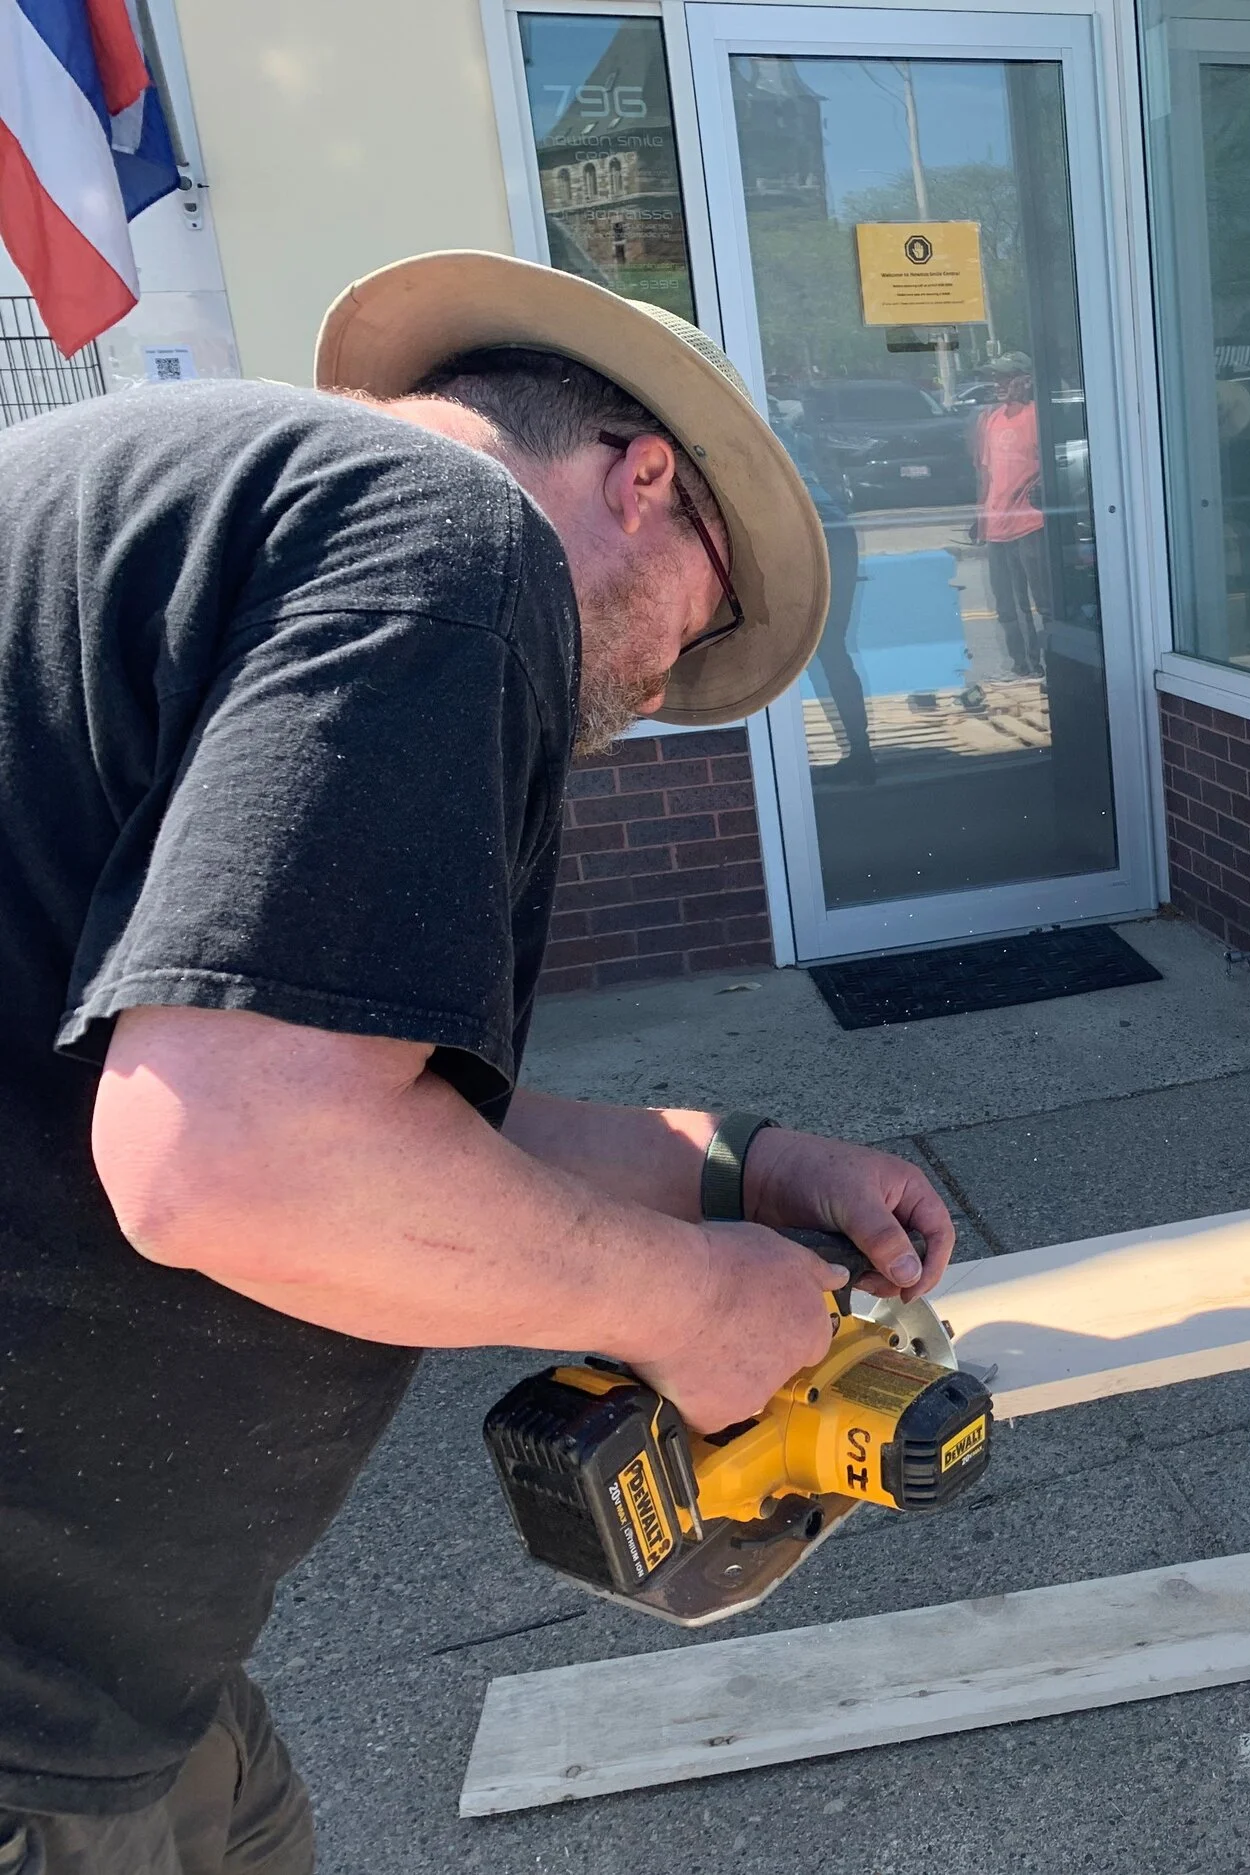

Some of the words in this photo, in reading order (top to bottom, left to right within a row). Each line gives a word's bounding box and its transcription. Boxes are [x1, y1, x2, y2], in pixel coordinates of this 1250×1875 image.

[543, 85, 648, 118] 796
[542, 134, 613, 148] newton
[616, 134, 665, 148] smile
[574, 148, 637, 162] cente
[634, 1560, 645, 1578] ION
